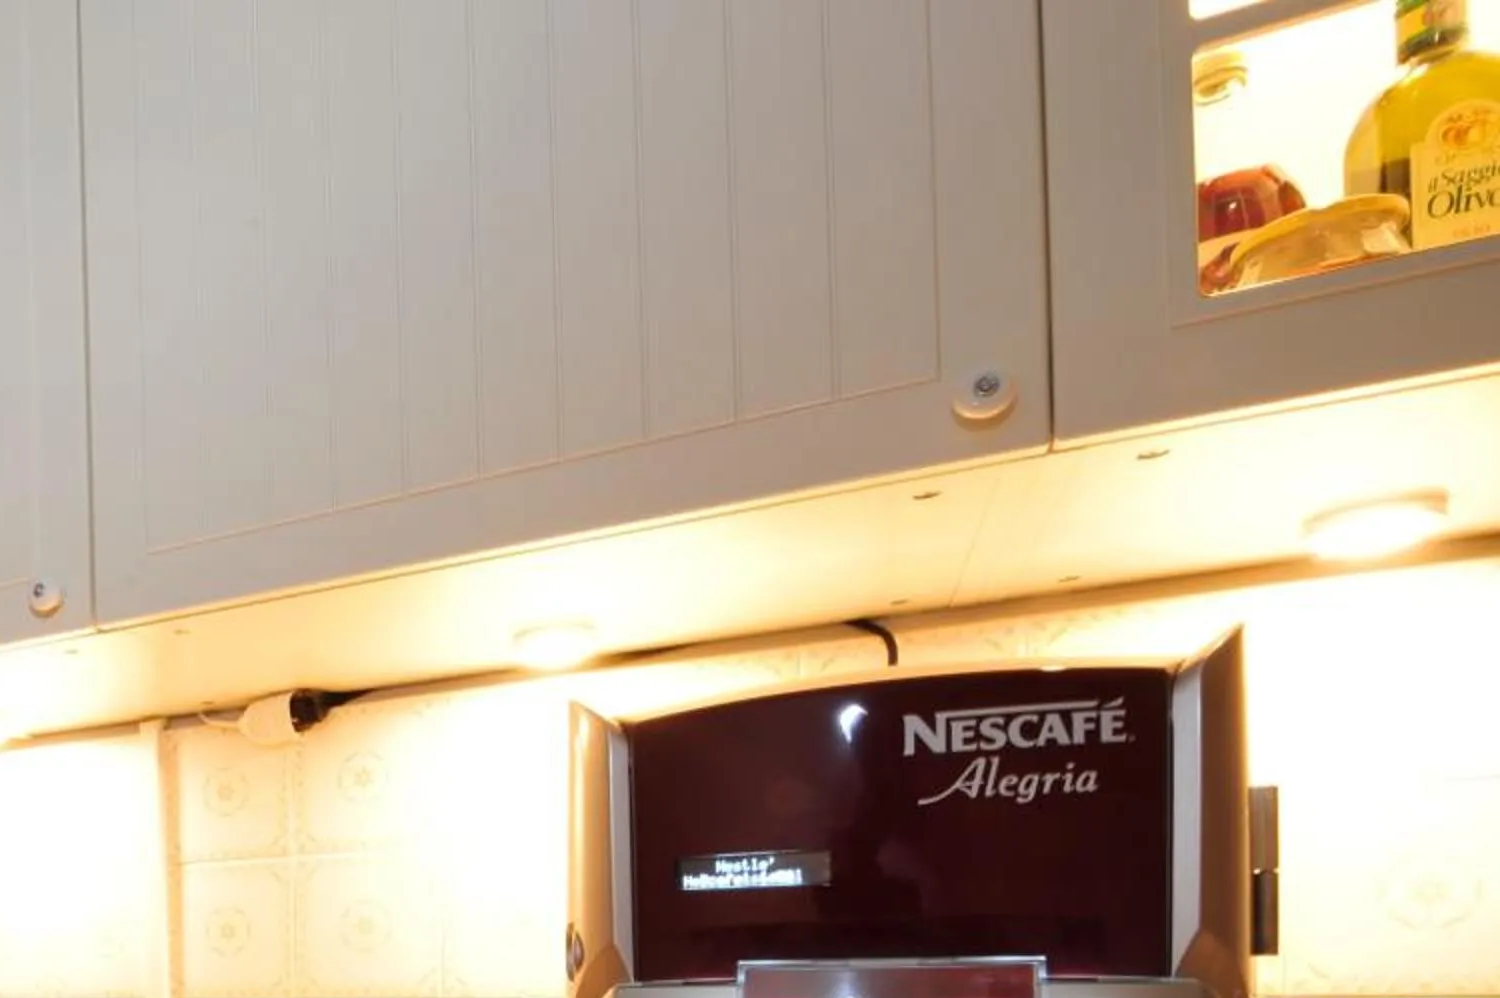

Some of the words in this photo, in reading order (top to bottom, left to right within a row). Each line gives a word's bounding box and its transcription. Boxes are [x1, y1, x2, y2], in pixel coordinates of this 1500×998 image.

[1441, 160, 1500, 187] Saggi
[902, 697, 1127, 756] NESCAFÉ
[917, 756, 1098, 805] Alegria
